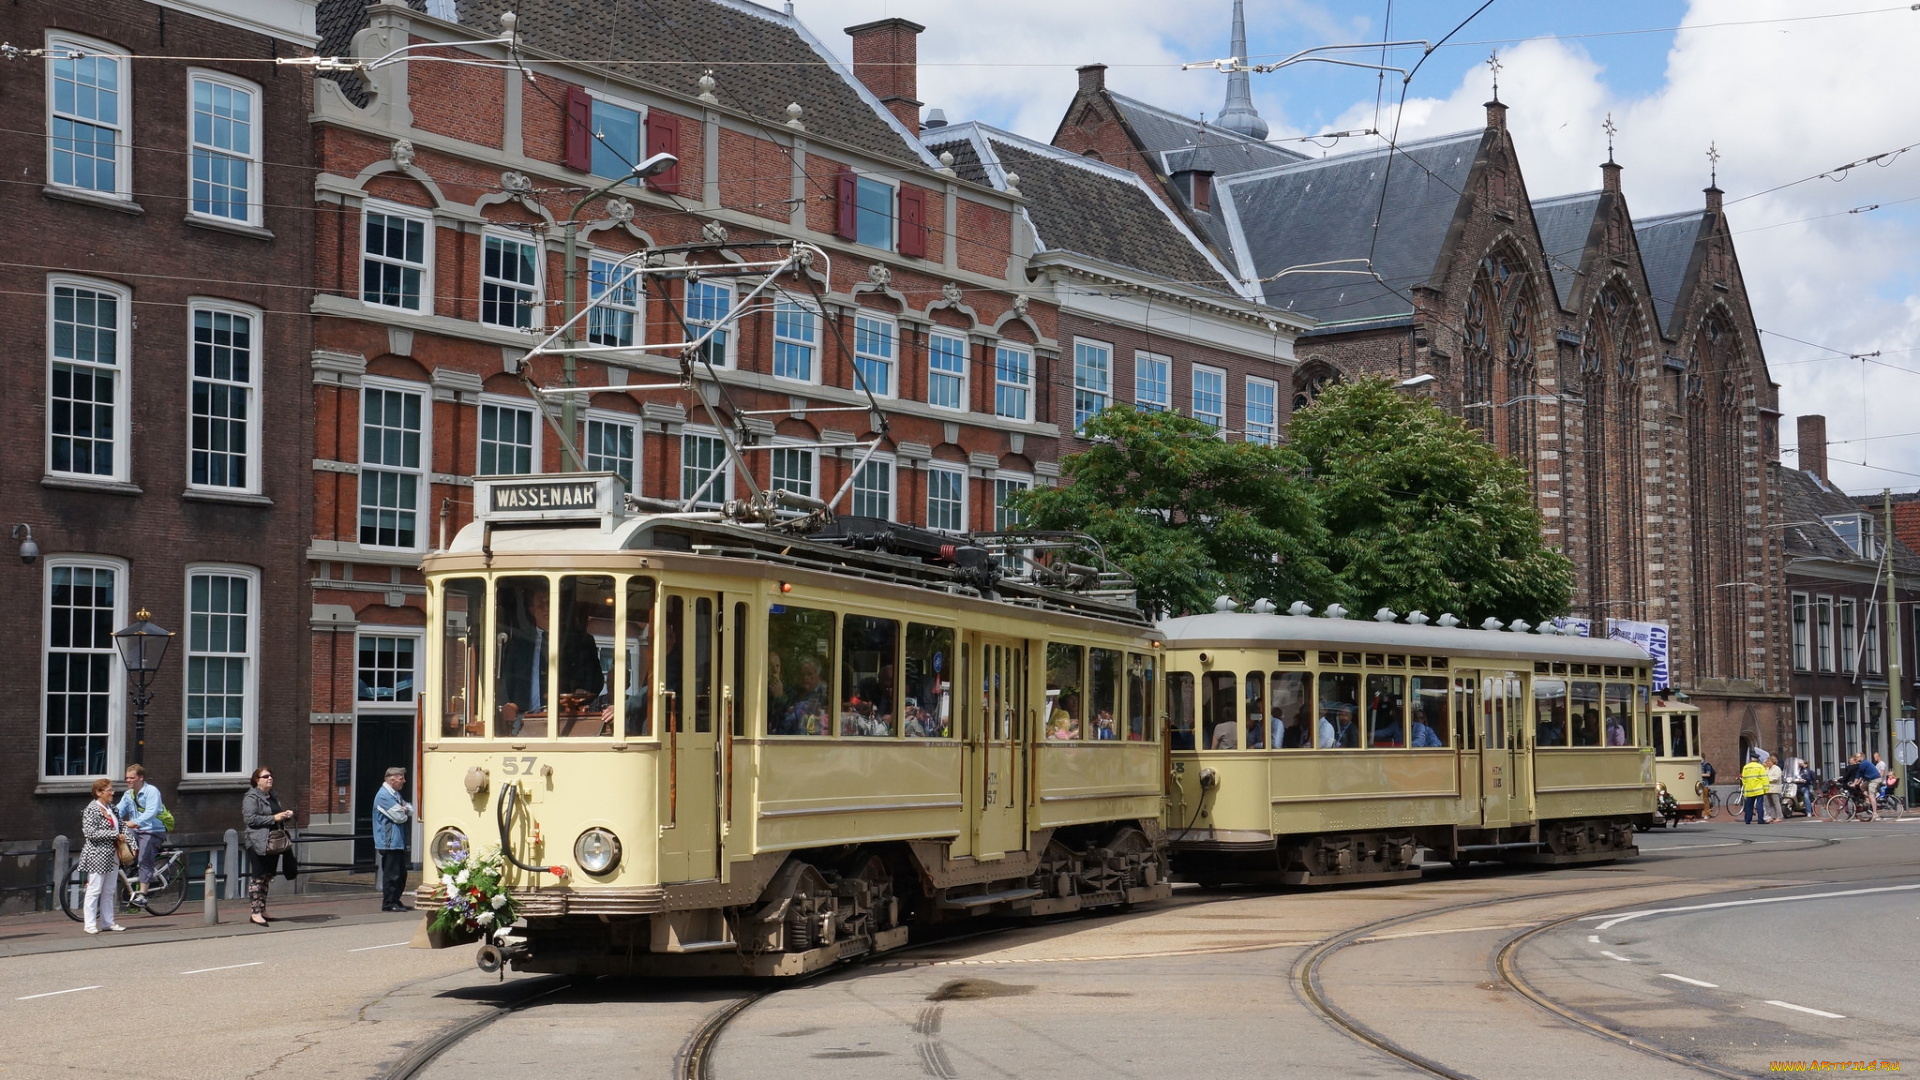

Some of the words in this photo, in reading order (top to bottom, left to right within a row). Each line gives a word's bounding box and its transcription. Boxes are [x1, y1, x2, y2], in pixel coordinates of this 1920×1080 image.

[496, 484, 594, 507] WASSENAAR
[502, 756, 537, 776] 57
[1678, 772, 1685, 780] 2
[987, 790, 997, 804] 57
